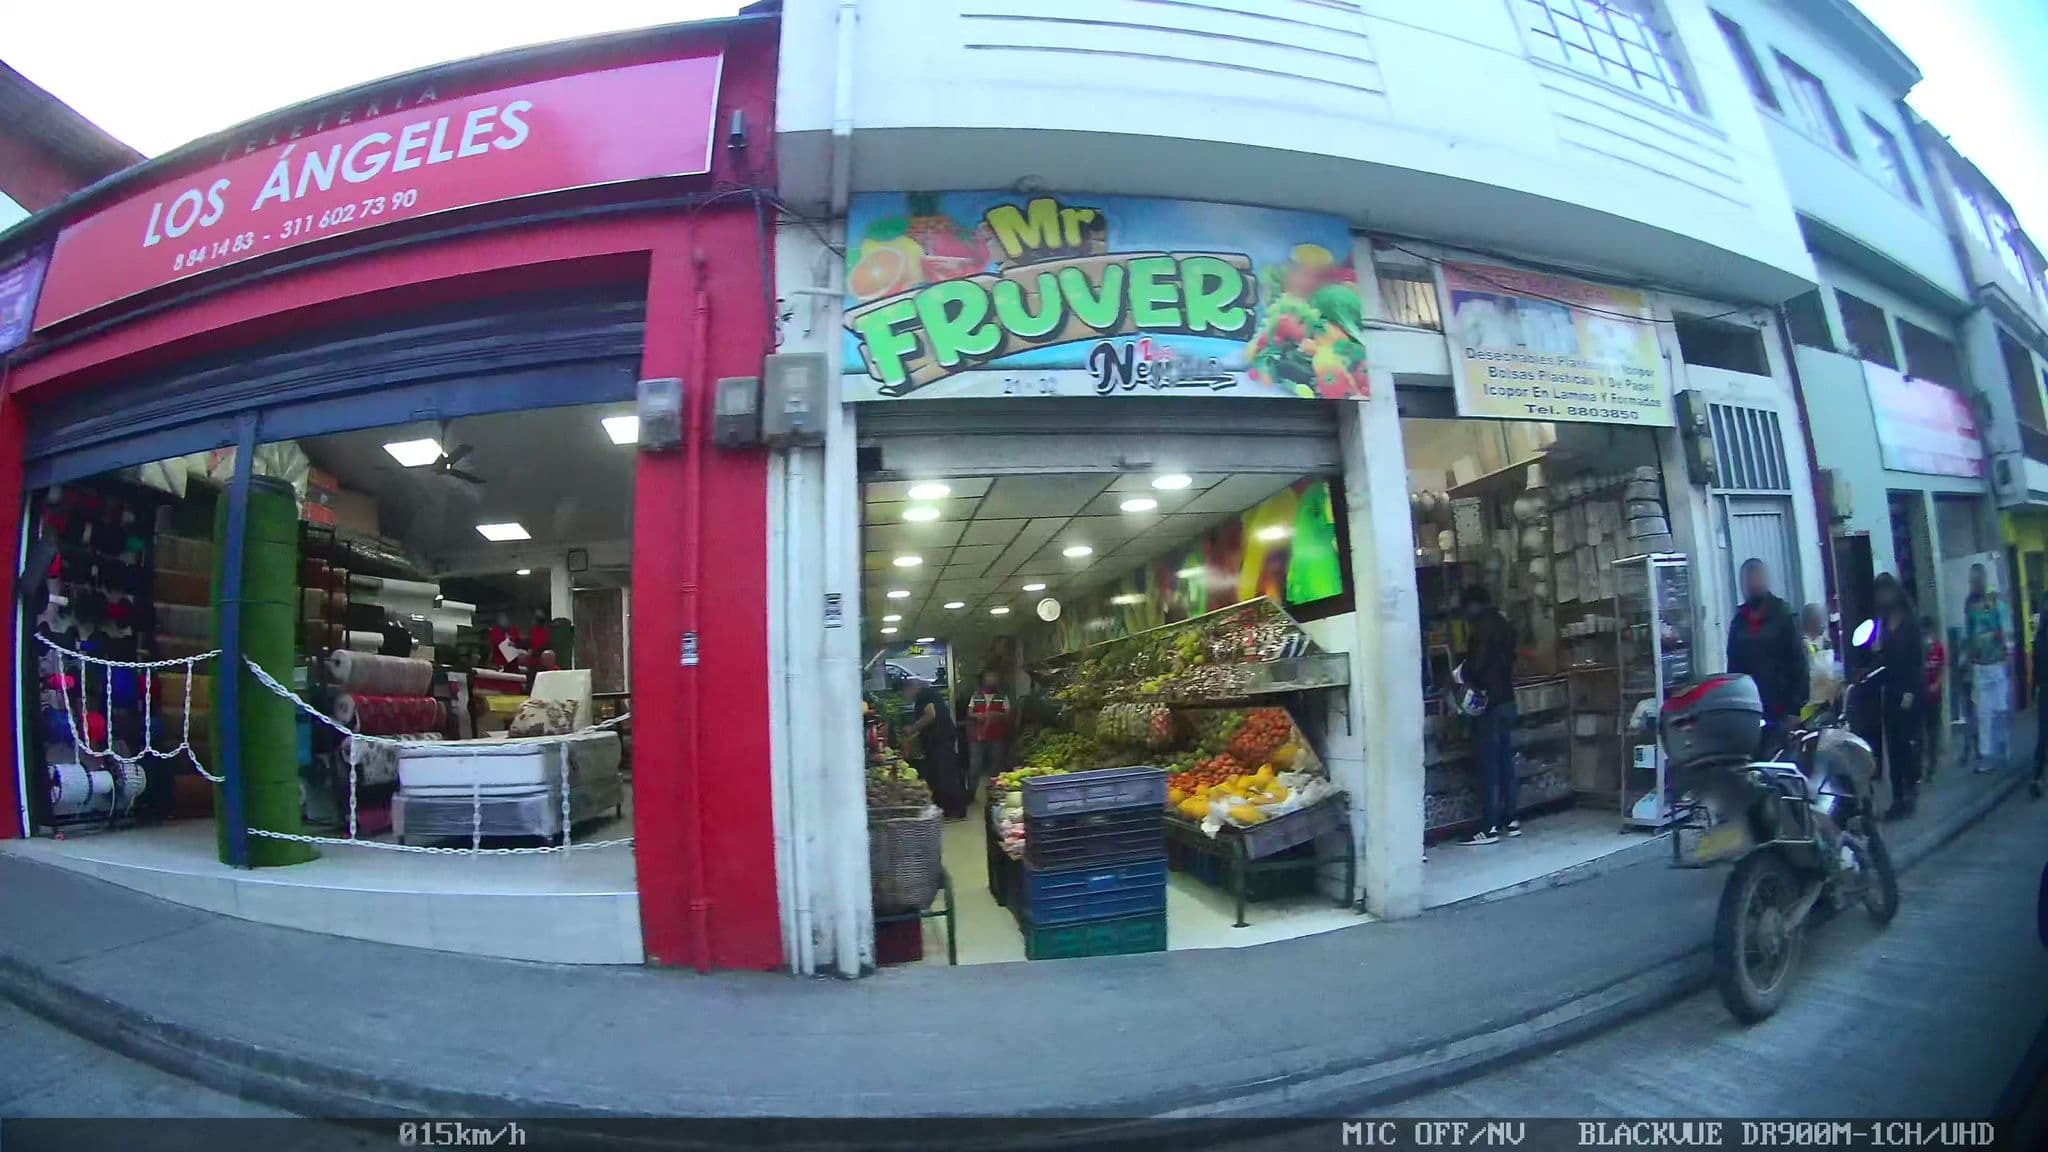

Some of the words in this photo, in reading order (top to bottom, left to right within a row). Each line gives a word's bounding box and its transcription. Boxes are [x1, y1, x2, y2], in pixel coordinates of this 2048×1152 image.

[143, 178, 230, 247] LOS
[251, 100, 533, 211] ÁNGELES
[173, 253, 185, 271] 8
[186, 247, 207, 267] 84
[210, 241, 229, 260] 14
[231, 231, 254, 252] 83
[280, 215, 313, 240] 311
[318, 203, 357, 229] 602
[359, 197, 386, 219] 73
[391, 188, 418, 211] 90
[985, 198, 1096, 258] Mr
[855, 256, 1250, 389] FRUVER
[1482, 383, 1529, 399] Icopor
[1531, 386, 1549, 398] En
[1600, 391, 1608, 403] Y
[1523, 403, 1561, 415] Tel.
[1567, 405, 1640, 421] 8803850
